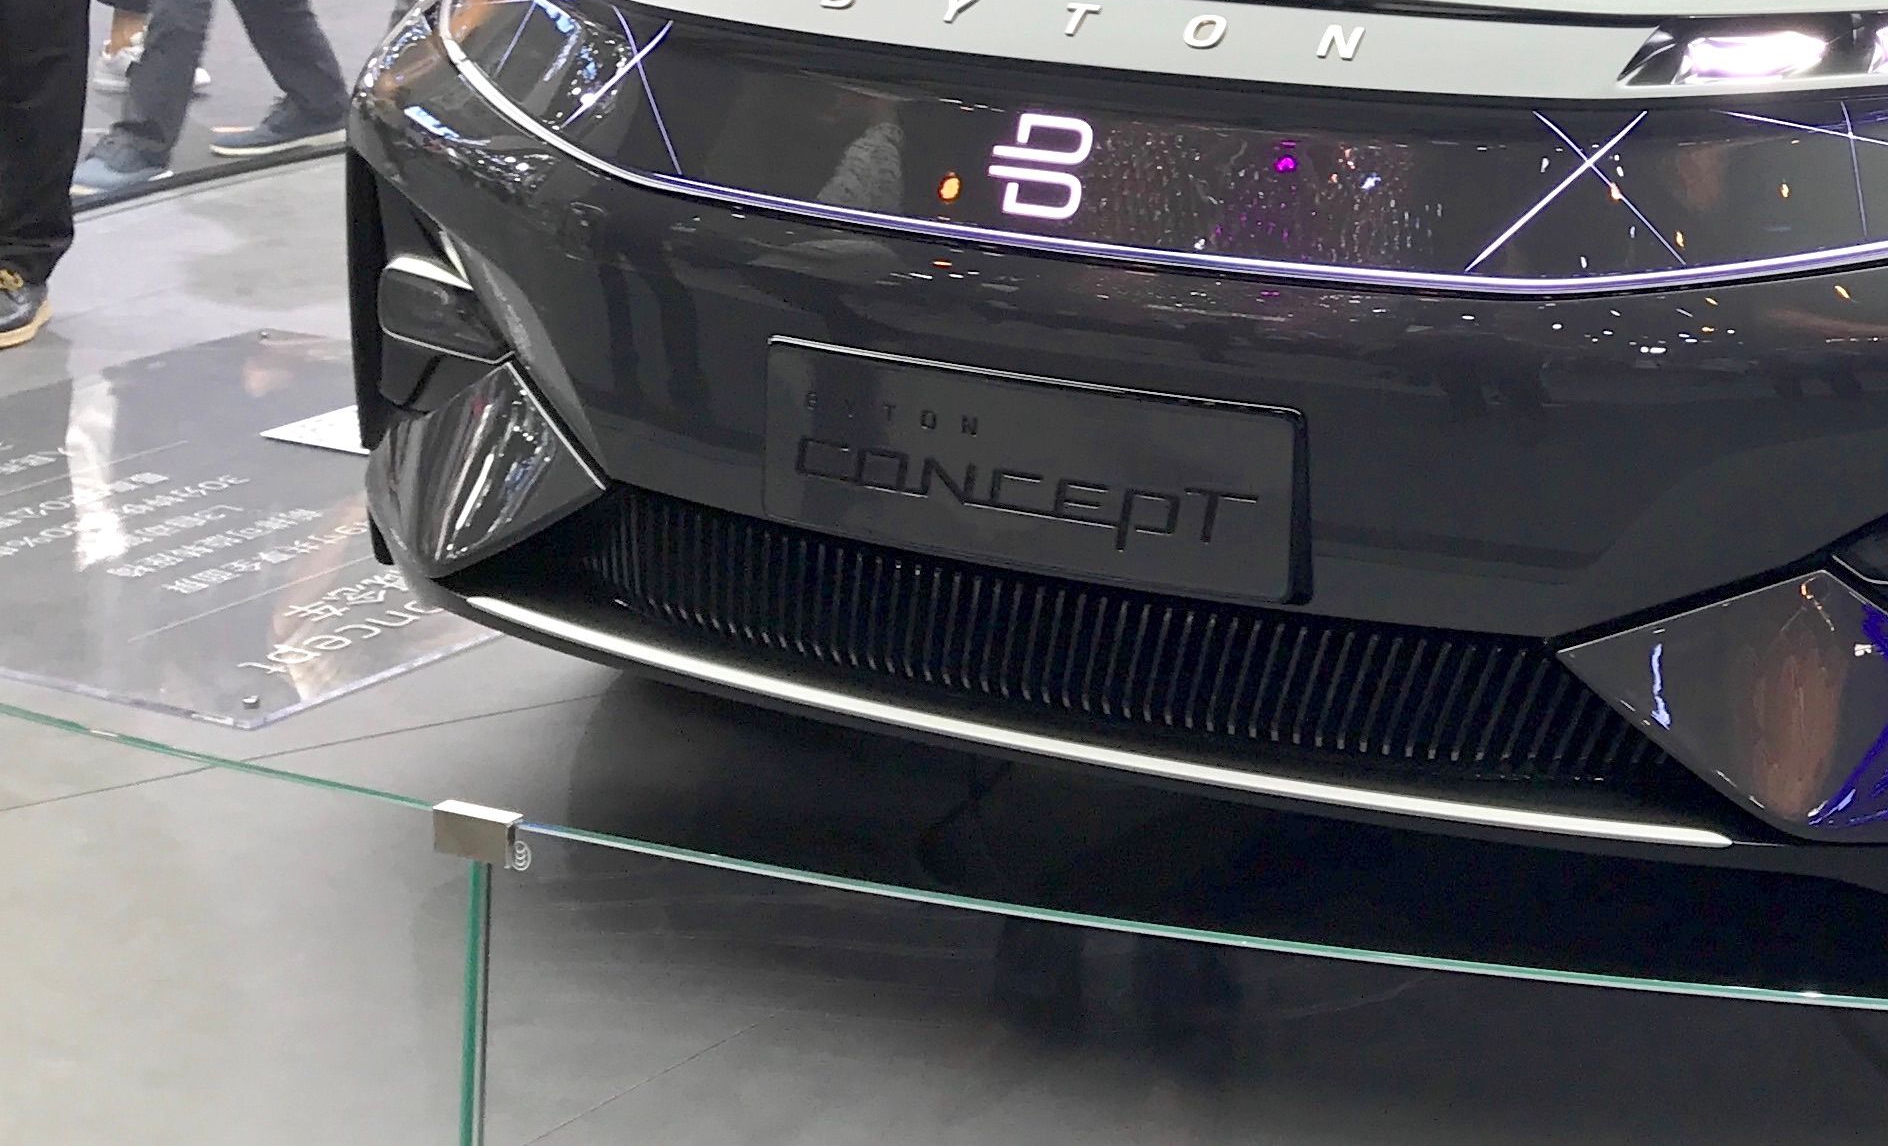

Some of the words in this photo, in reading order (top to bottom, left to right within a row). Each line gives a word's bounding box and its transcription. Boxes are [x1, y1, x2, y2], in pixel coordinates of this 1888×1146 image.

[161, 520, 368, 595] 9寸共享全面屏
[237, 600, 444, 675] oncept
